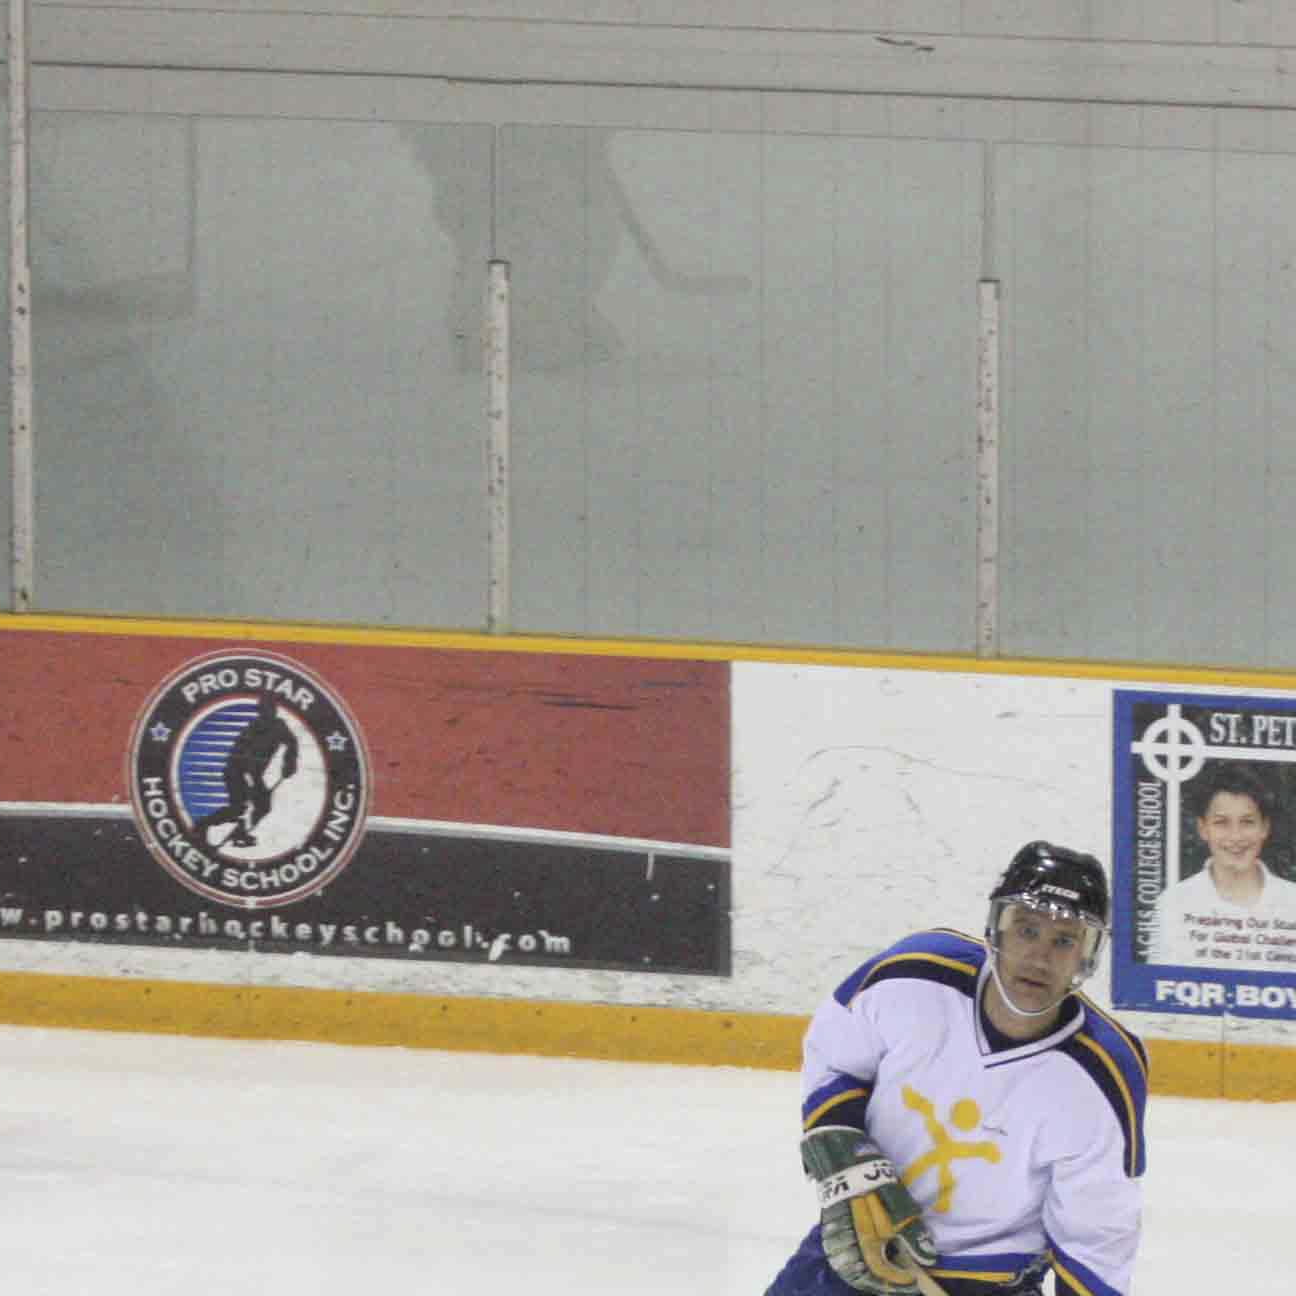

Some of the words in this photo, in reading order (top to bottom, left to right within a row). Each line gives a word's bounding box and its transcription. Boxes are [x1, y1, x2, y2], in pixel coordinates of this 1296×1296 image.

[181, 669, 239, 702] PRO
[245, 668, 315, 710] STAR
[1209, 713, 1247, 744] ST.
[142, 777, 220, 877] HOCKEY
[222, 846, 334, 890] SCHOOL
[323, 783, 356, 841] INC.
[1137, 781, 1162, 838] SCHOOL
[1137, 840, 1161, 904] COLLEGE
